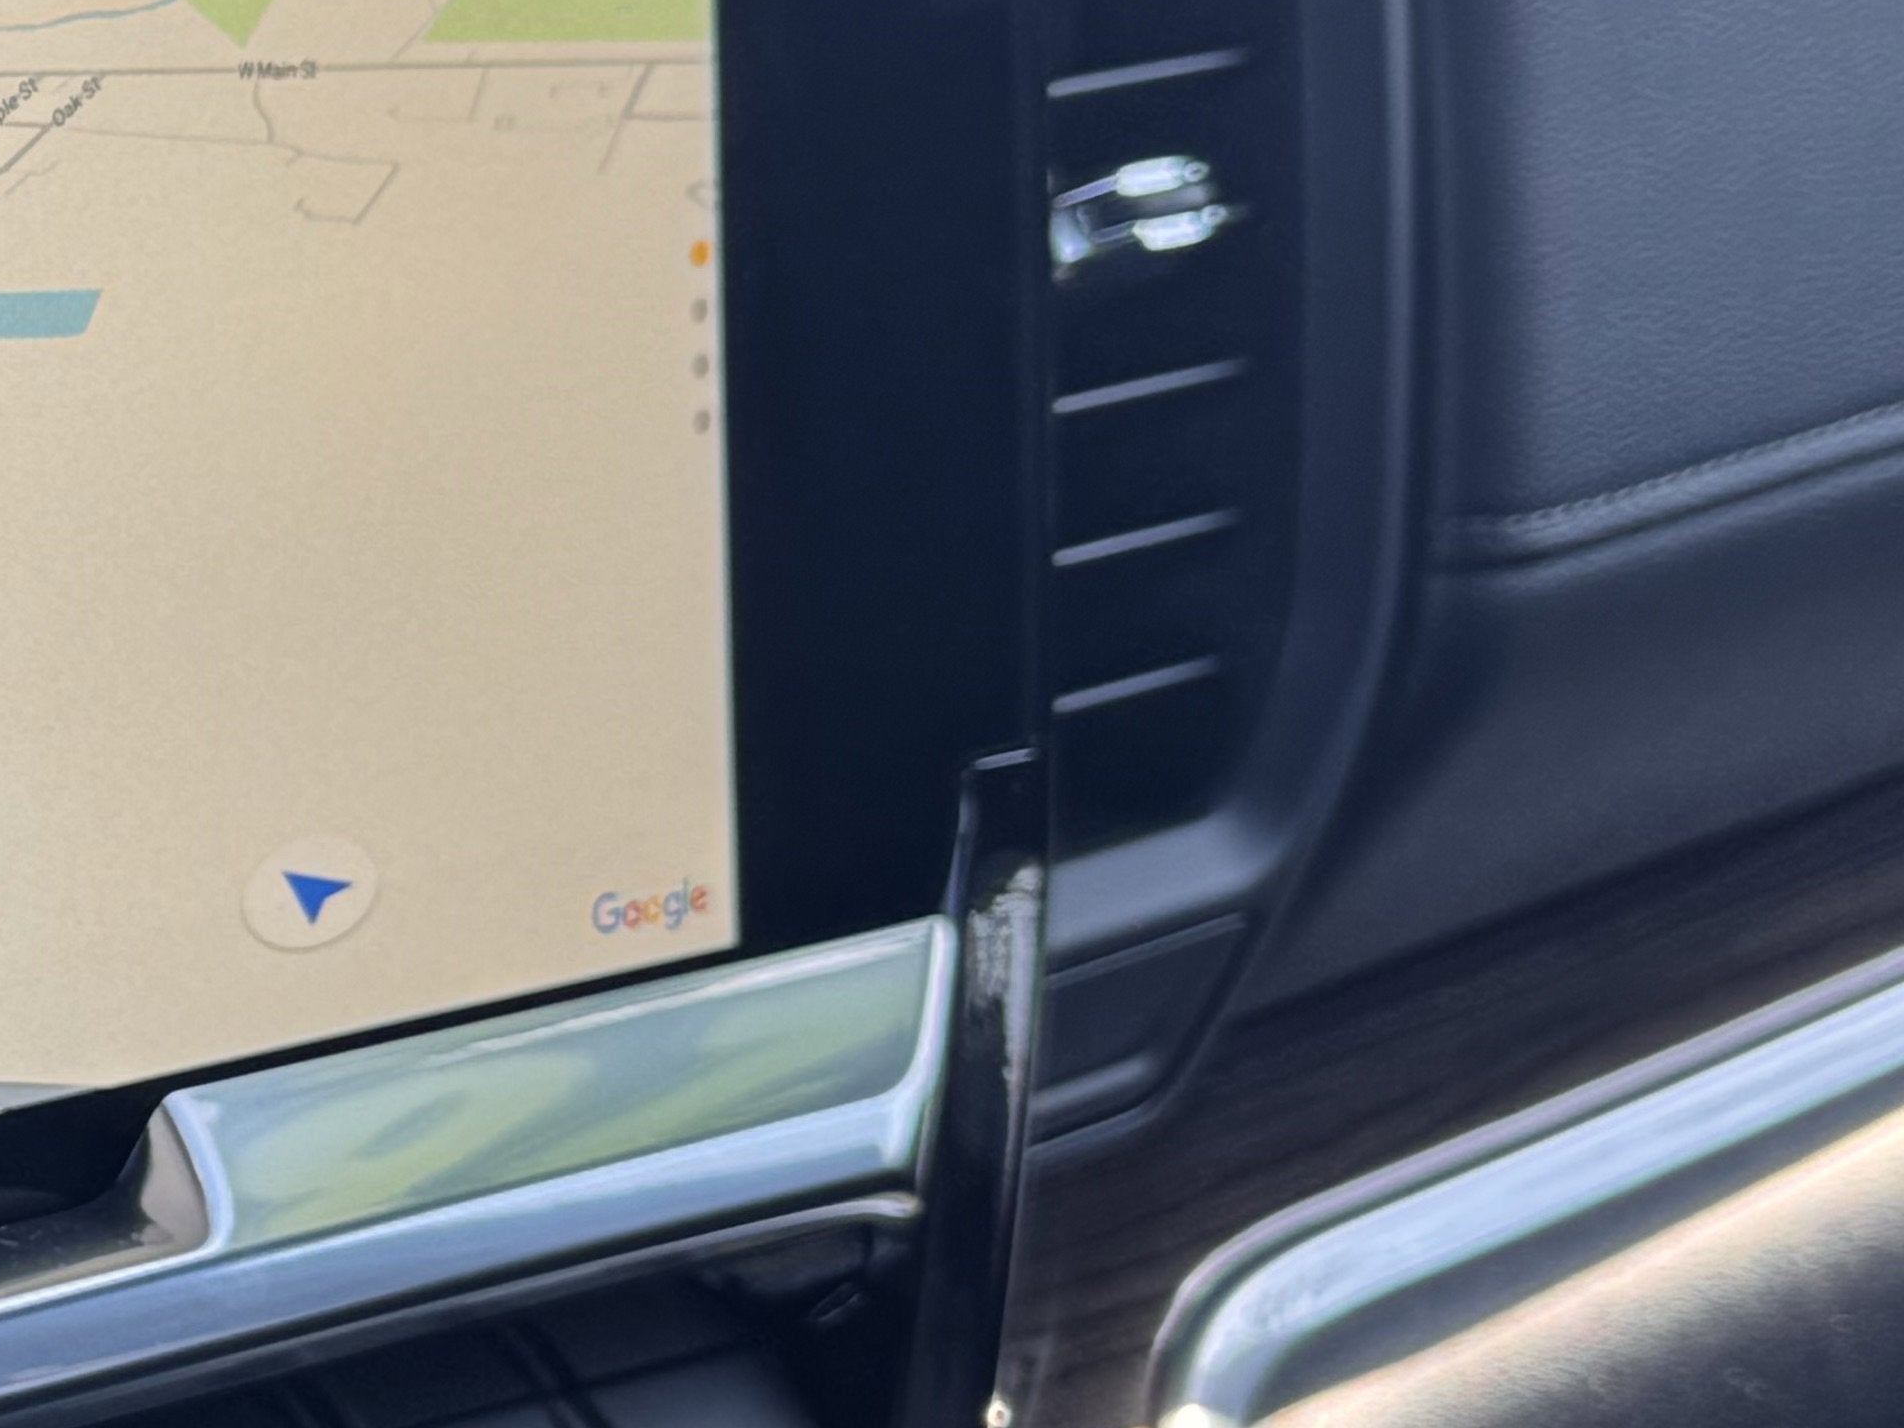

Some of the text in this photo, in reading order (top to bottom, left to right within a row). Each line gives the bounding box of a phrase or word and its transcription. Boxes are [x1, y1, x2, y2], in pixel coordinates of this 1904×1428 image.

[19, 73, 40, 101] St
[51, 74, 103, 128] Oak St
[593, 877, 710, 935] Google
